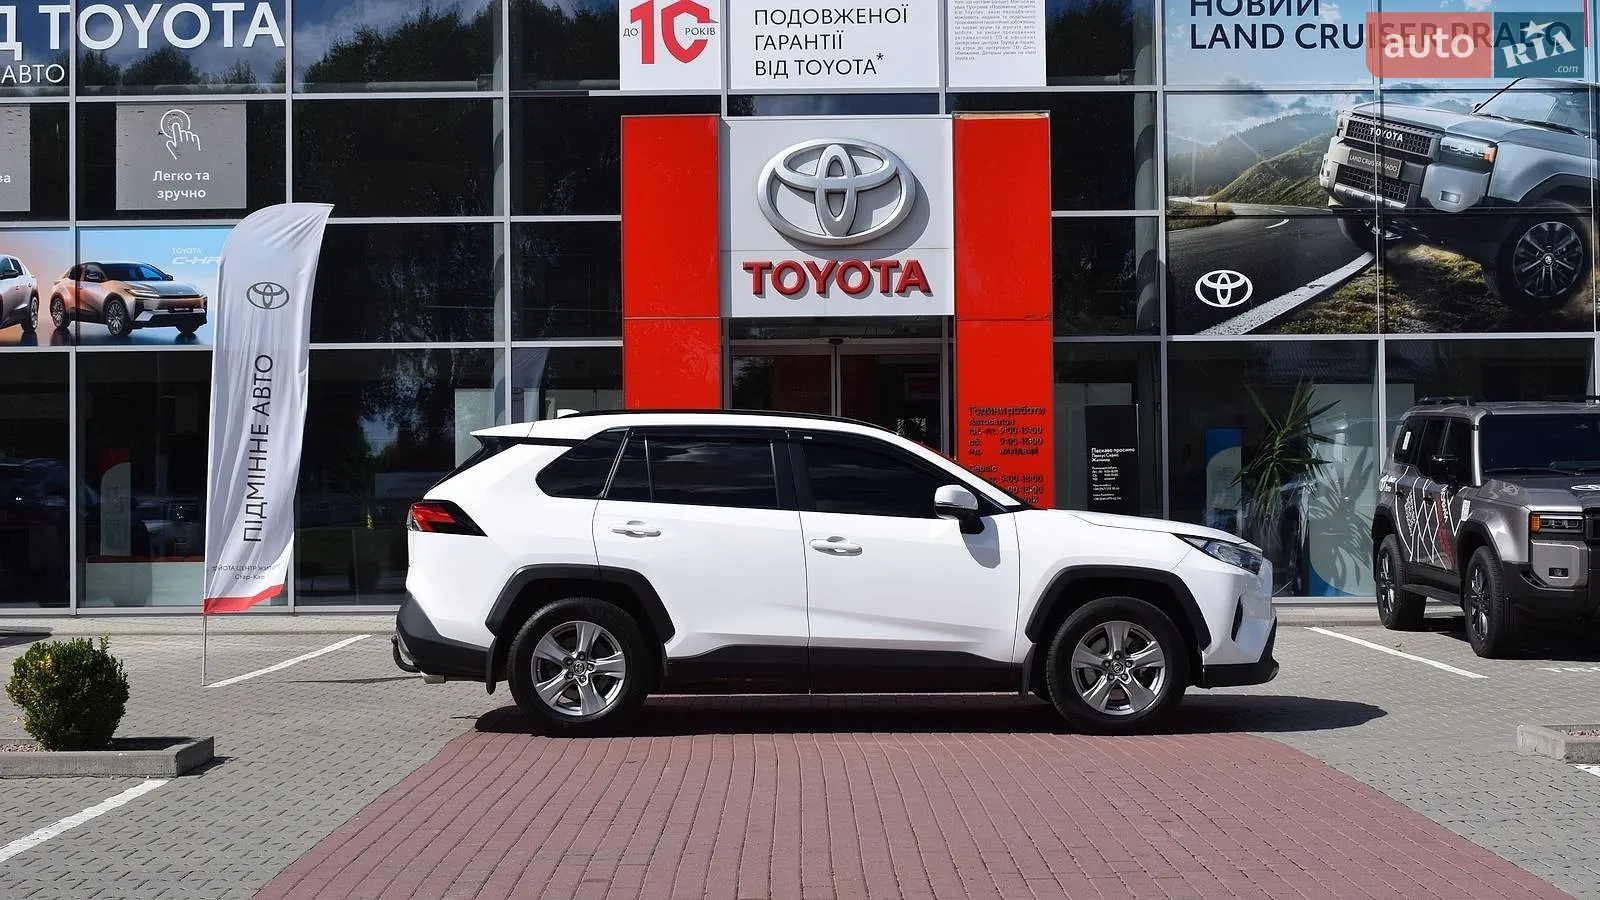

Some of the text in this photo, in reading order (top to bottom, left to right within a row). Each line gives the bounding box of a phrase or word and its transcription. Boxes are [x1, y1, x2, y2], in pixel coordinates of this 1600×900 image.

[754, 3, 909, 28] ПОДОВЖЕНОЇ
[38, 2, 285, 50] TOYOTA
[622, 28, 639, 38] ДО
[684, 27, 716, 36] РОКІВ
[1190, 23, 1284, 49] LAND
[754, 29, 844, 51] ГАРАНТІЇ
[755, 60, 789, 79] ВІД
[1370, 127, 1403, 142] TOYOTA
[153, 171, 210, 181] Легко та
[157, 189, 206, 201] зручно
[172, 247, 201, 255] TOYOTA
[742, 259, 931, 296] TOYOTA
[243, 354, 273, 542] ПІДМІННЕ АВТО
